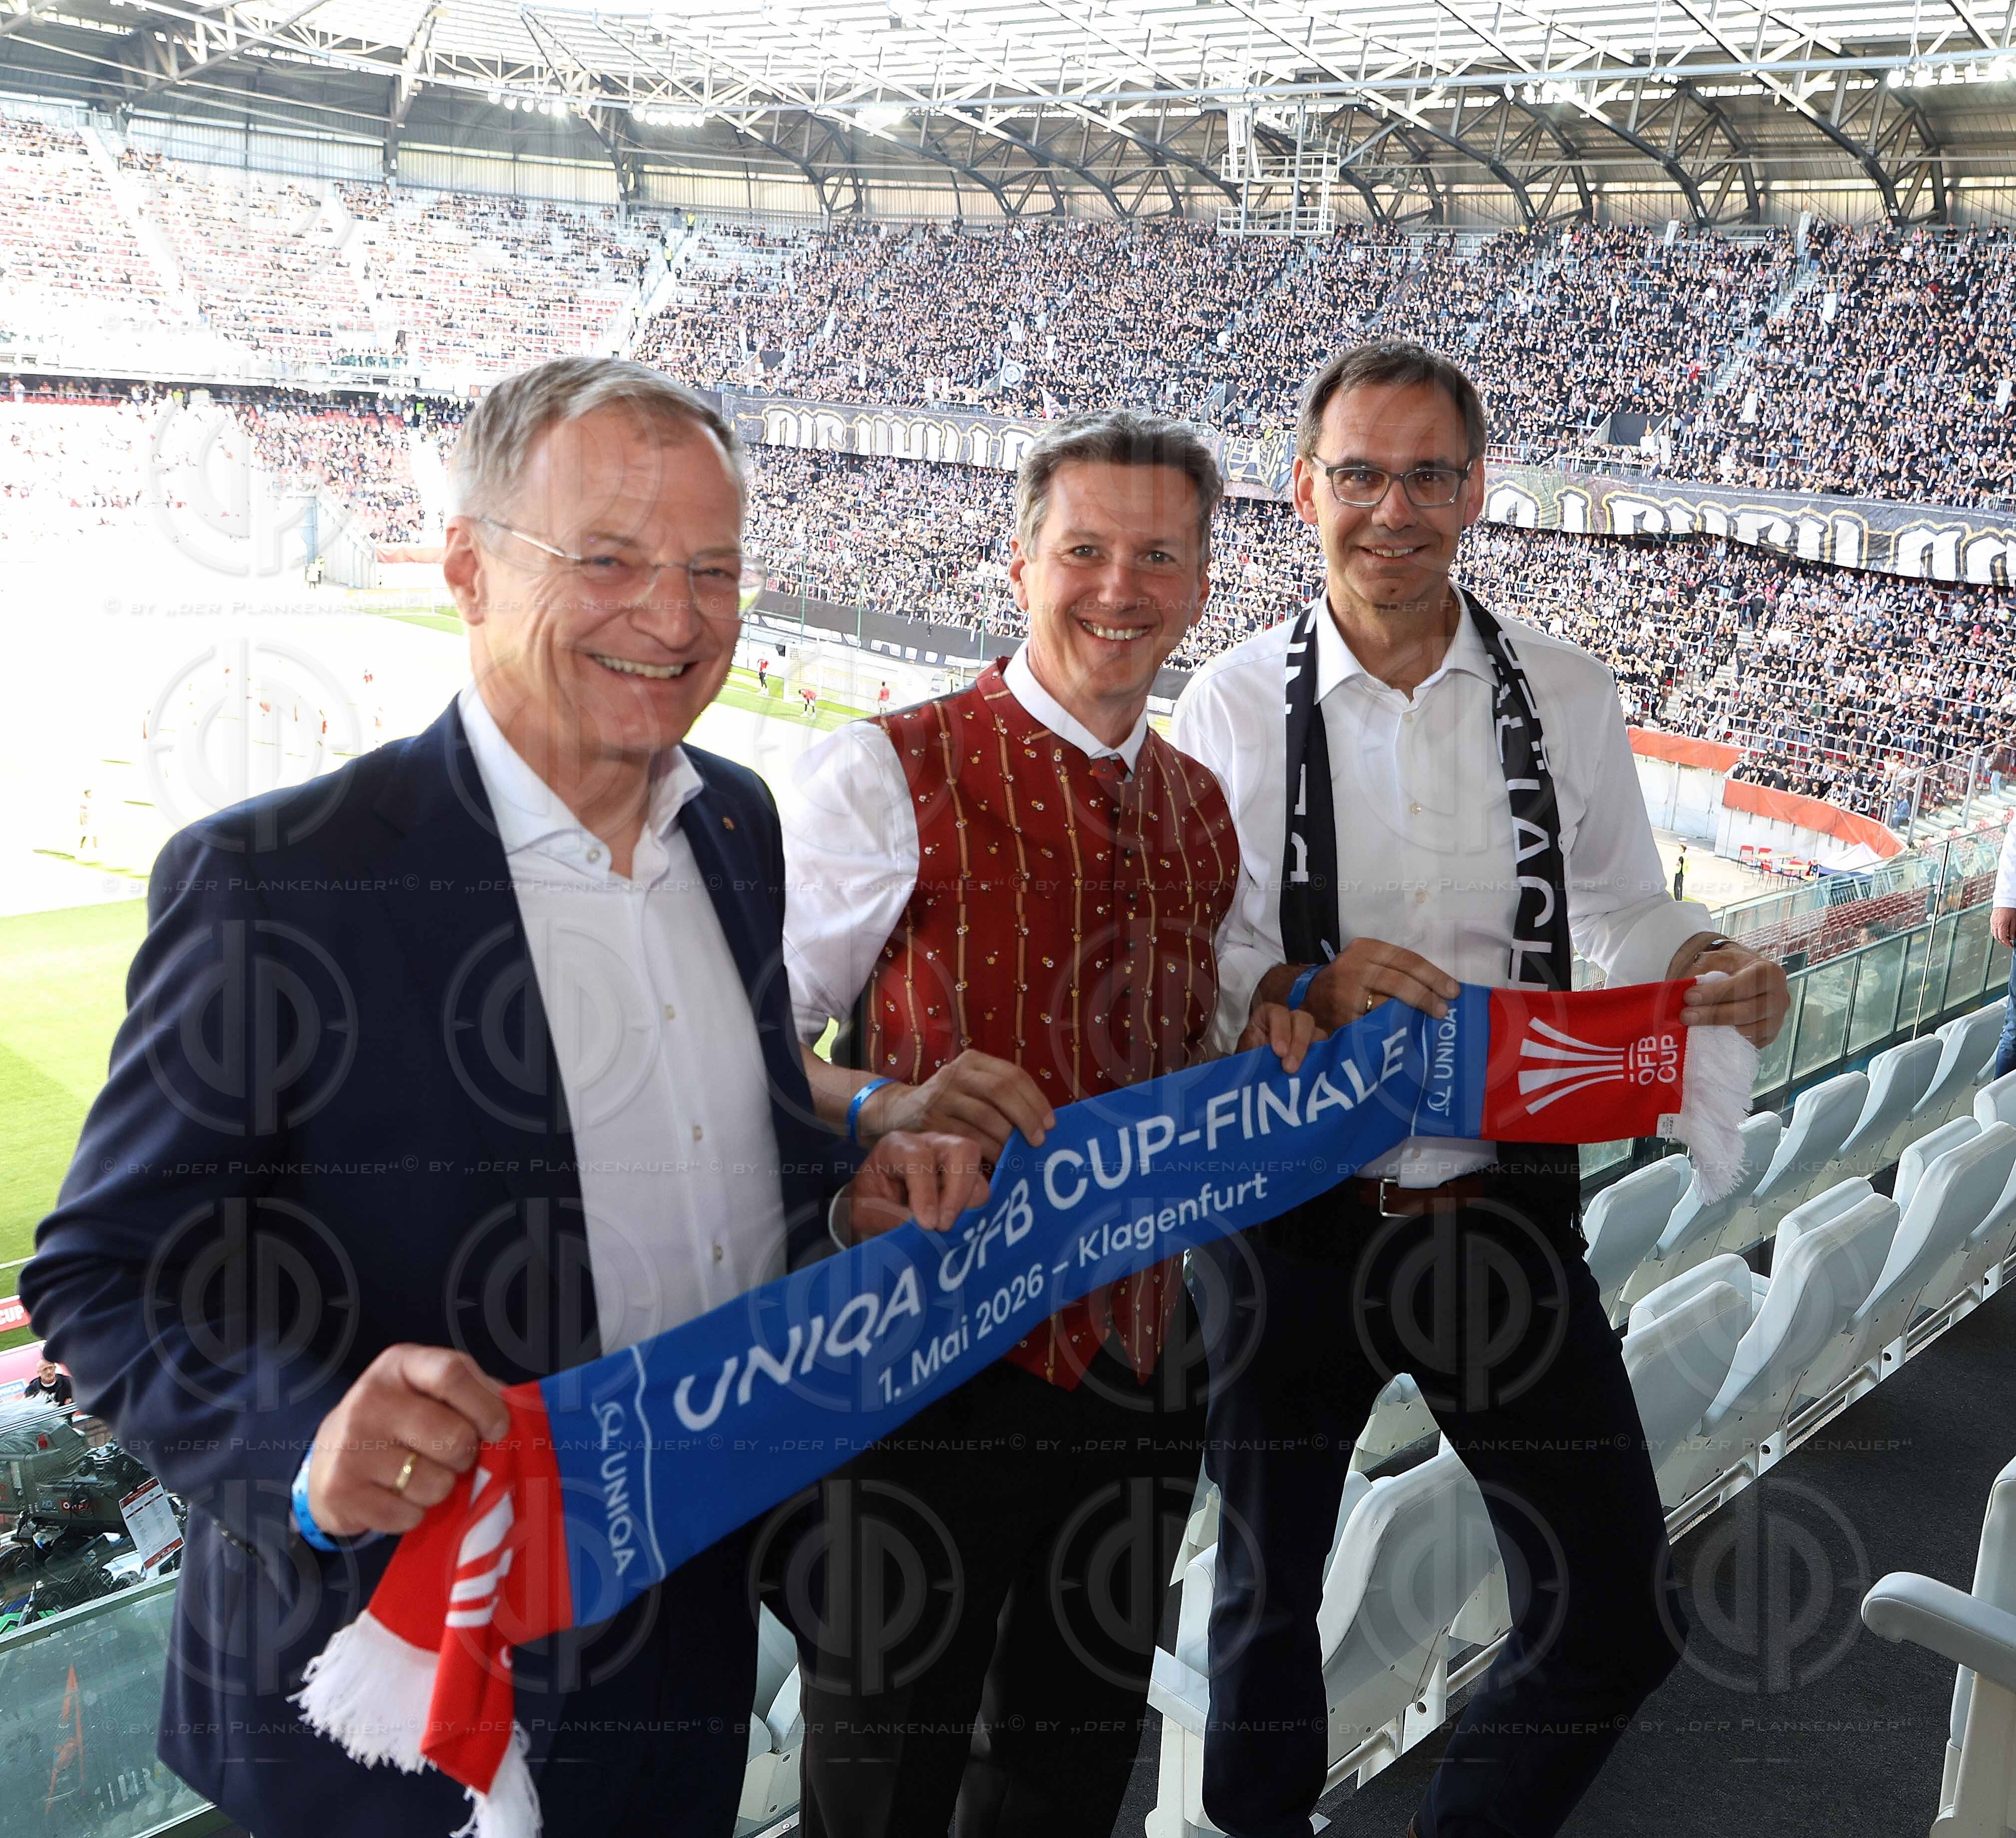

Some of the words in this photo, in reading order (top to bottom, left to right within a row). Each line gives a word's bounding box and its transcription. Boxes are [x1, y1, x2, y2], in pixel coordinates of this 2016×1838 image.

[1434, 1006, 1455, 1080] UNIQA
[1657, 1034, 1678, 1083] CUP
[674, 1265, 920, 1431] UNIQA
[1044, 1027, 1407, 1210] CUP-FINALE
[879, 1368, 901, 1403] 1.
[911, 1322, 968, 1385] Mai
[977, 1262, 1044, 1340] 2026
[1079, 1172, 1268, 1268] Klagenfurt
[600, 1453, 636, 1576] UNIQA
